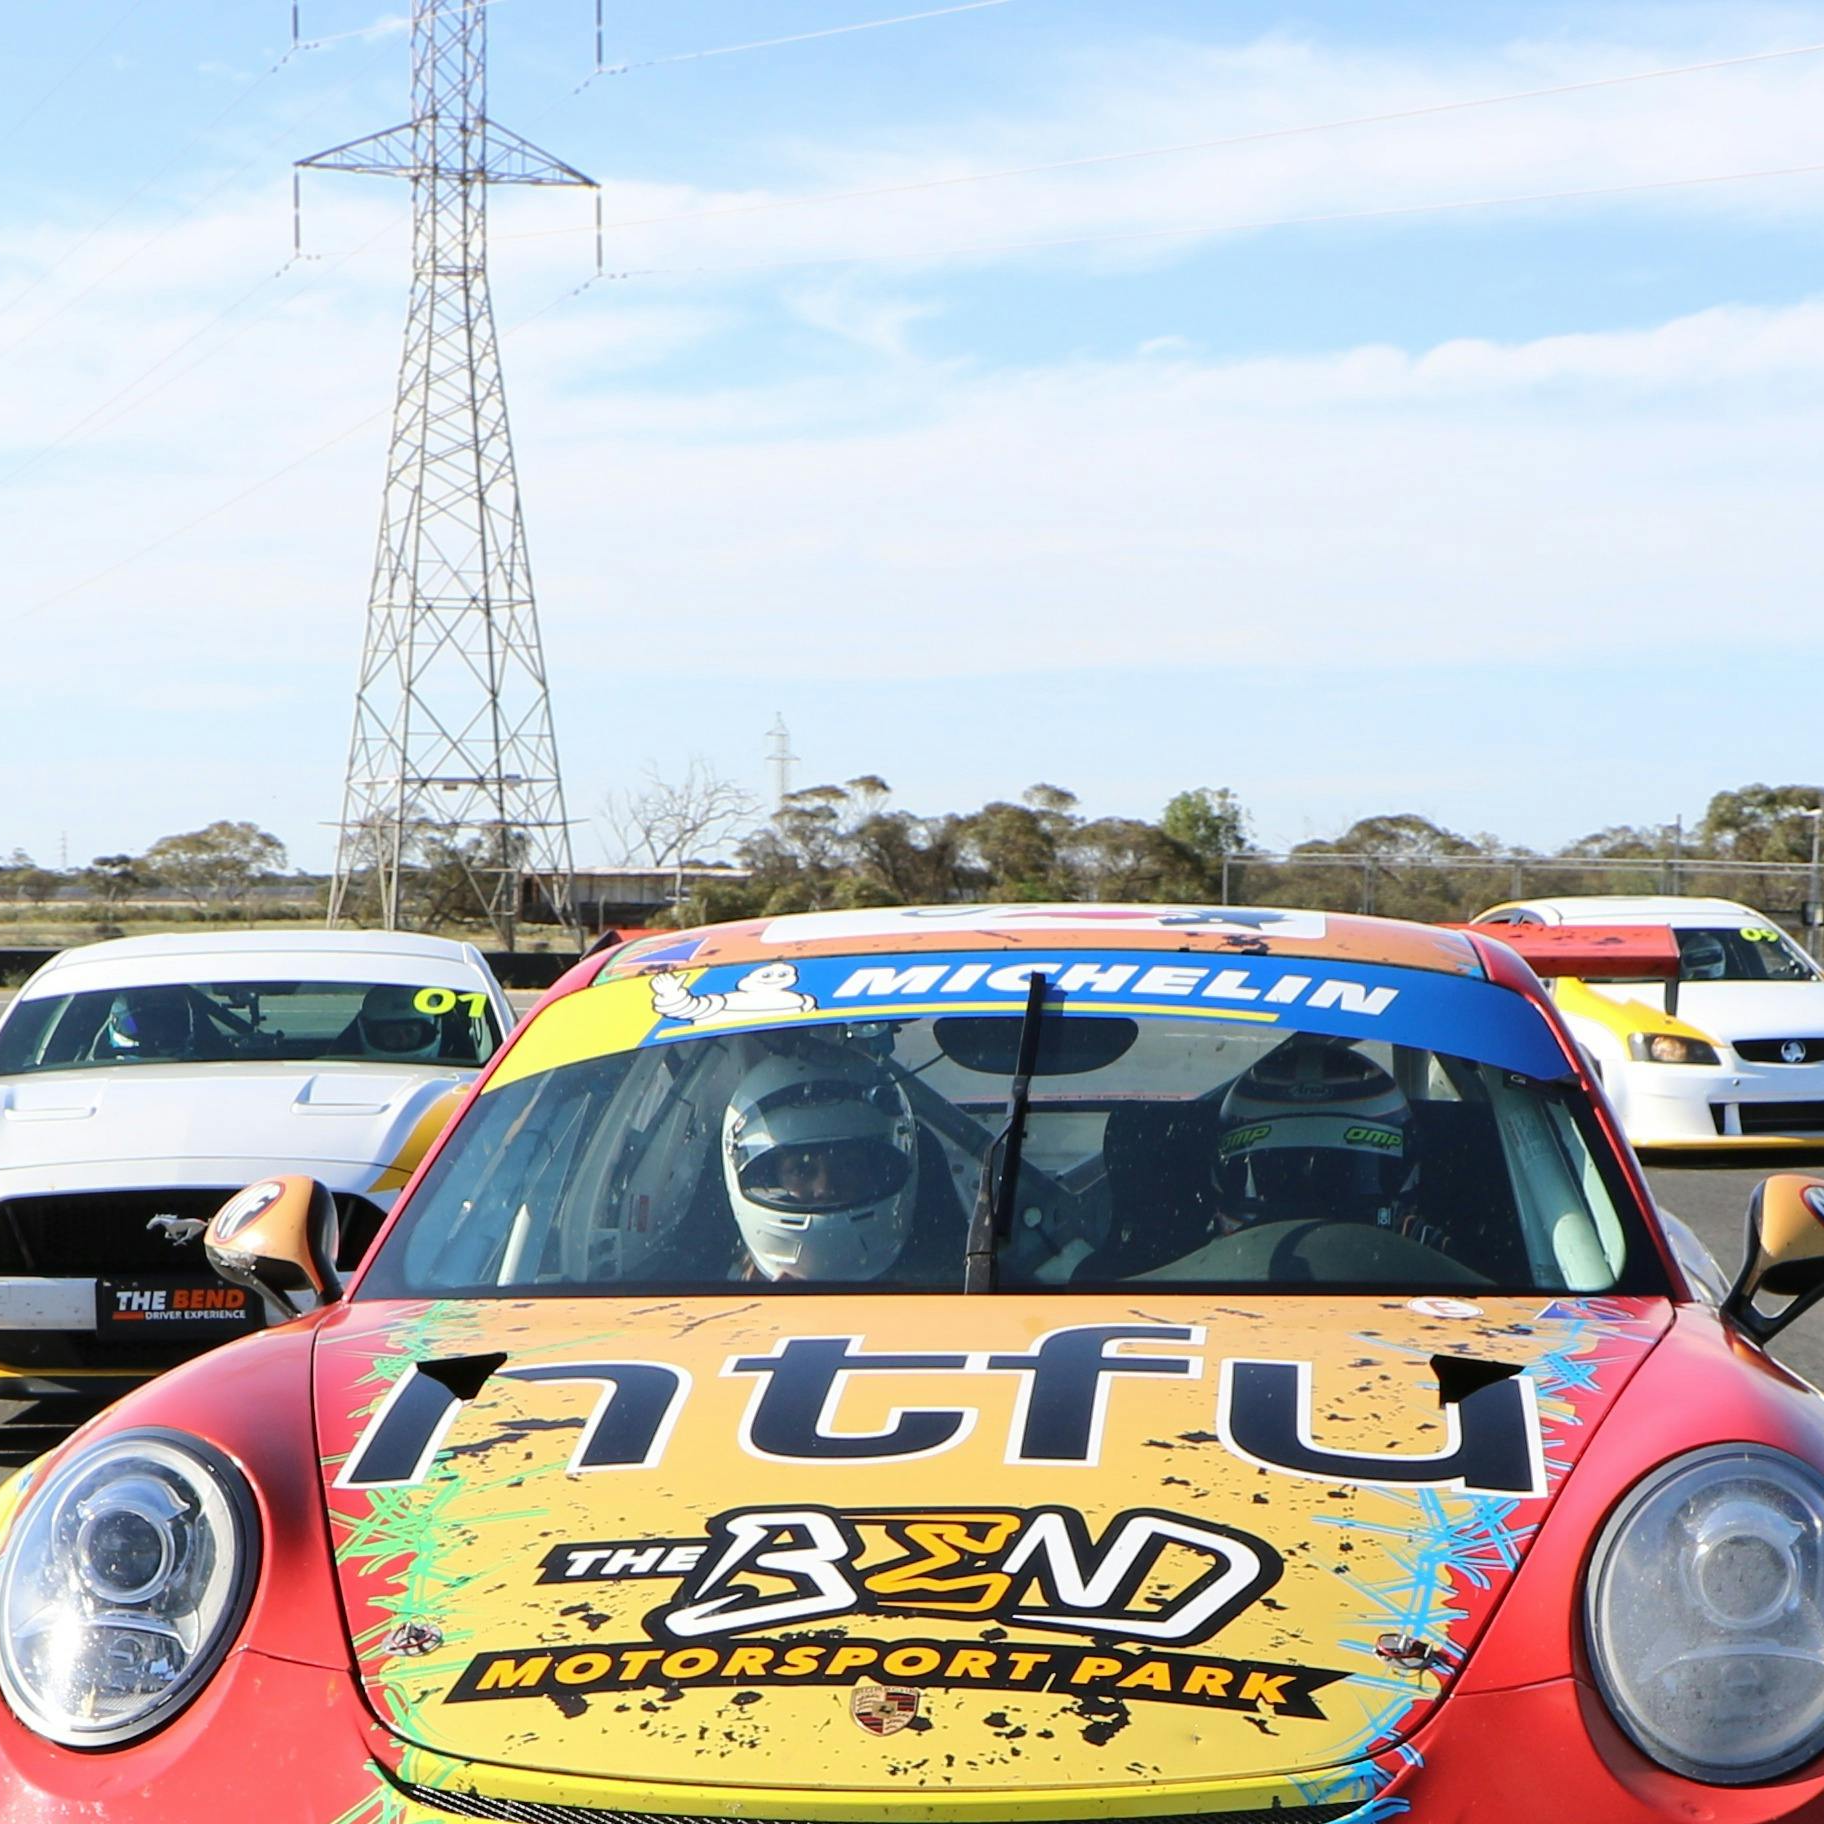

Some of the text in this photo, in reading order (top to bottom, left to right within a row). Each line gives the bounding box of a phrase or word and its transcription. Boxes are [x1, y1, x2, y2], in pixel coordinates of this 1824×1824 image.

[1739, 927, 1779, 942] 09
[413, 987, 488, 1018] 01
[832, 962, 1400, 1016] MICHELIN
[116, 1288, 245, 1311] THE BEND
[145, 1309, 246, 1320] DRIVER EXPERIENCE
[332, 1323, 1548, 1498] ntfu
[566, 1511, 1262, 1640] THE BEND
[478, 1646, 1298, 1705] MOTORSPORT PARK
